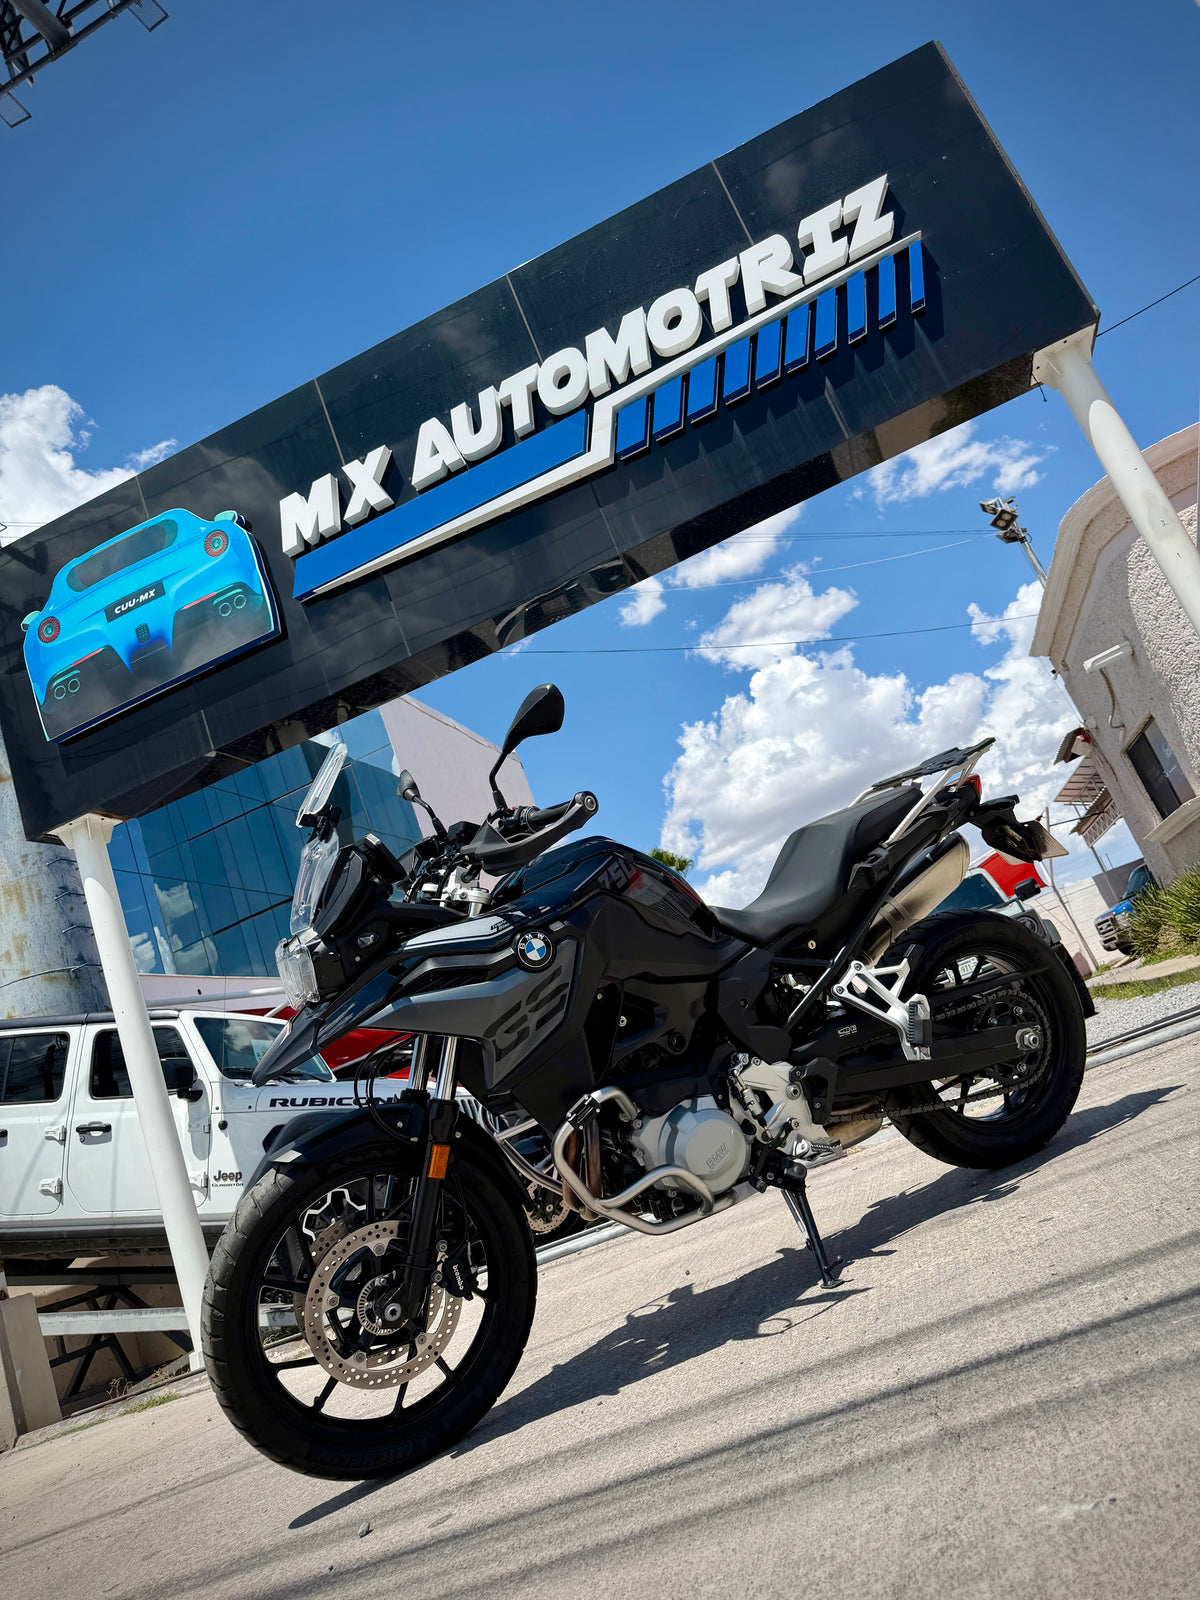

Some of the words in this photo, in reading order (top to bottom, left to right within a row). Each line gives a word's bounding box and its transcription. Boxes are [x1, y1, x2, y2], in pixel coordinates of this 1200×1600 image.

[280, 445, 394, 557] MX
[411, 174, 895, 491] AUTOMOTRIZ
[114, 589, 155, 614] CUU-MX
[213, 1170, 243, 1182] Jeep
[452, 1264, 464, 1290] brembo
